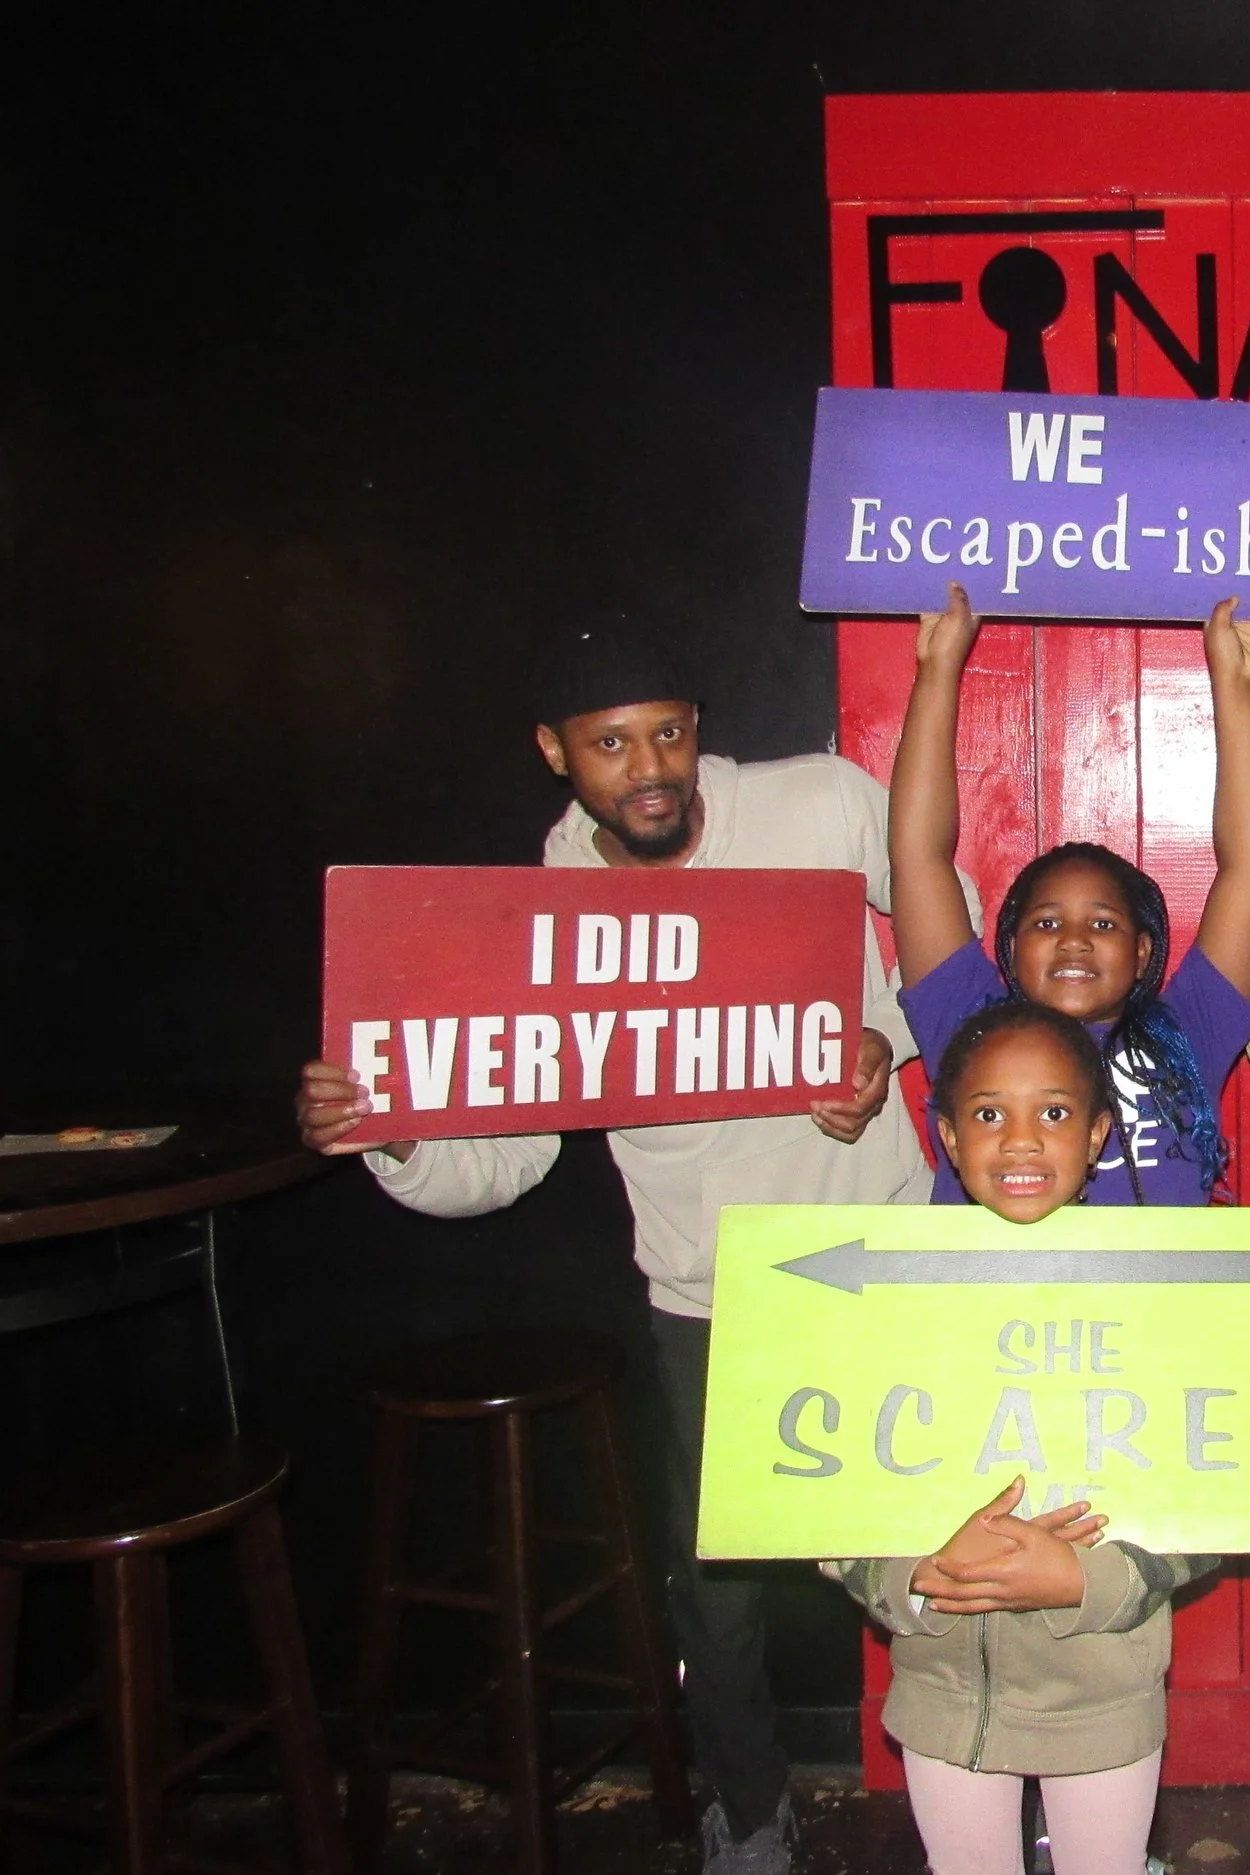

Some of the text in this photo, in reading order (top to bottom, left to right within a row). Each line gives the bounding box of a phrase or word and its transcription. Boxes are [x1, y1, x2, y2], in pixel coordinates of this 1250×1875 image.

[1008, 411, 1106, 485] WE
[531, 914, 700, 985] I DID
[352, 1001, 842, 1114] EVERYTHING
[995, 1319, 1125, 1374] SHE
